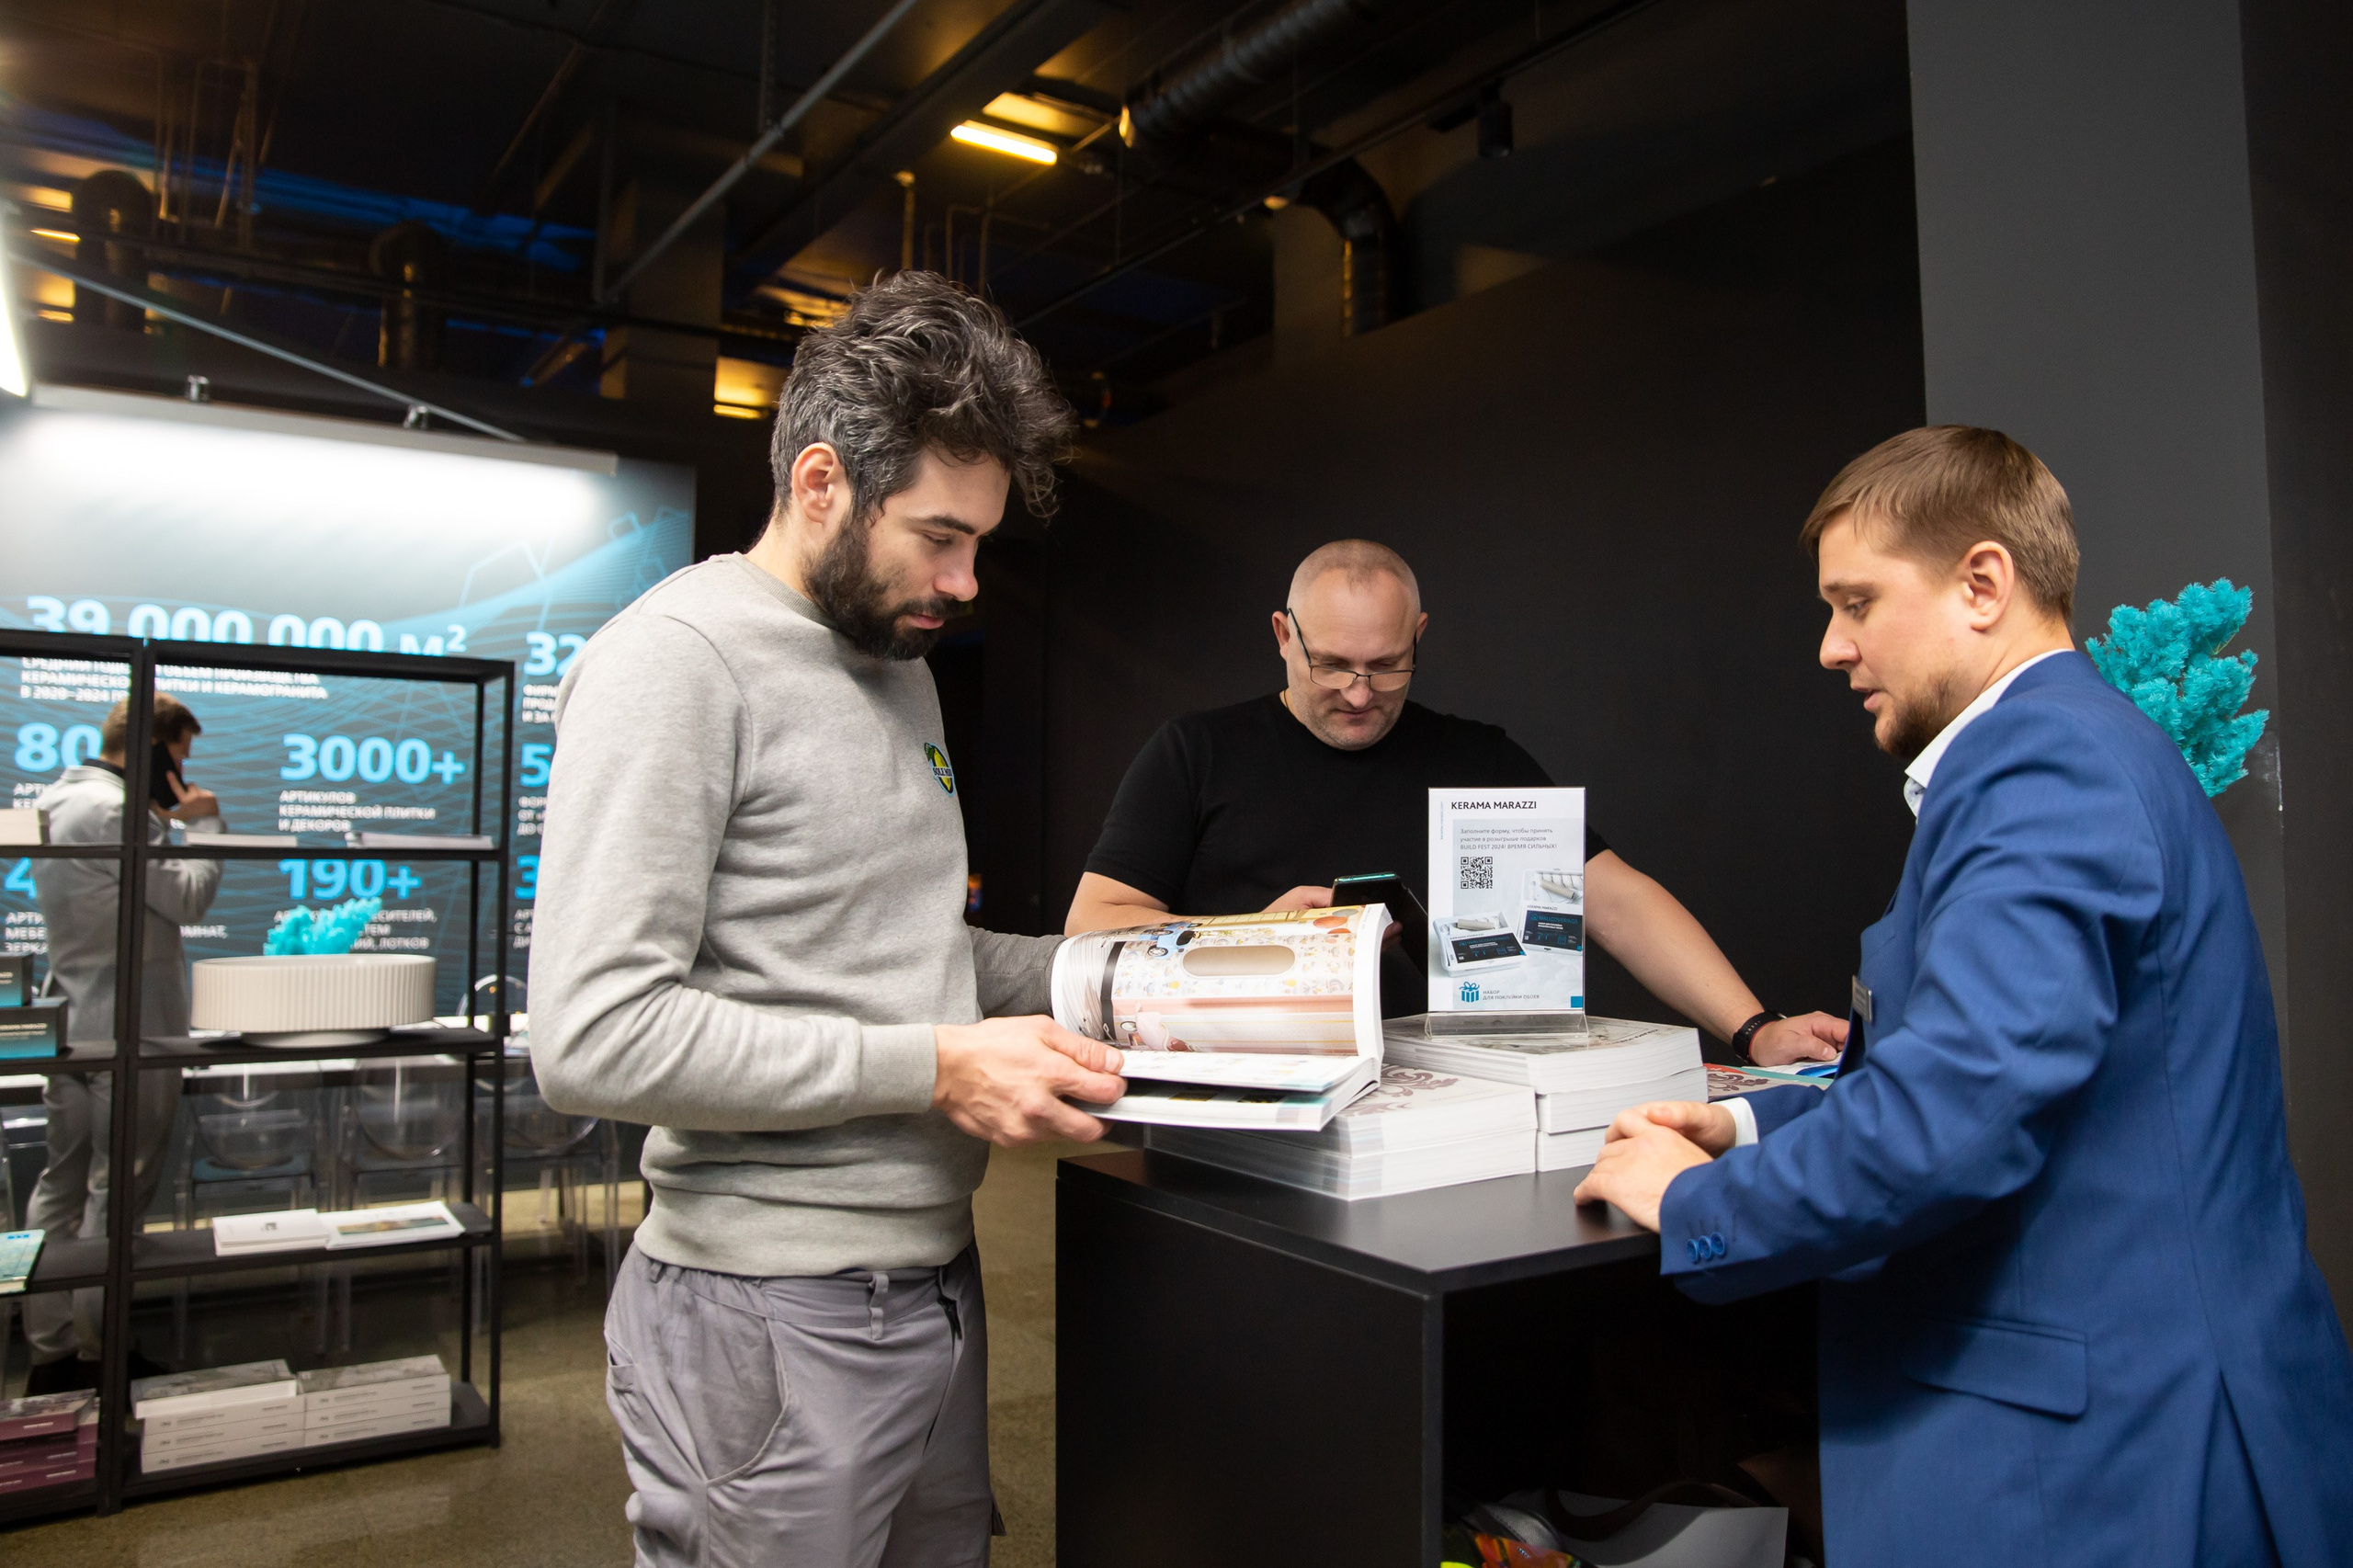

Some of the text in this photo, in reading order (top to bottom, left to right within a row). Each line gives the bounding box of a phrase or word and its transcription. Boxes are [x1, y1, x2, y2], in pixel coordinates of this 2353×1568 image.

[21, 670, 131, 688] КЕРАМИЧЕСКО
[280, 733, 465, 785] 3000+
[279, 790, 357, 804] АРТИКУЛОВ
[278, 804, 437, 820] КЕРАМИЧЕСКОЙ ПЛИТКИ
[1450, 801, 1537, 810] KERAMA MARAZZI
[278, 818, 351, 833] И ДЕКОРОВ
[278, 858, 422, 900] 190+
[5, 926, 48, 940] МЕБЕ
[380, 937, 429, 950] ЛОТКОВ
